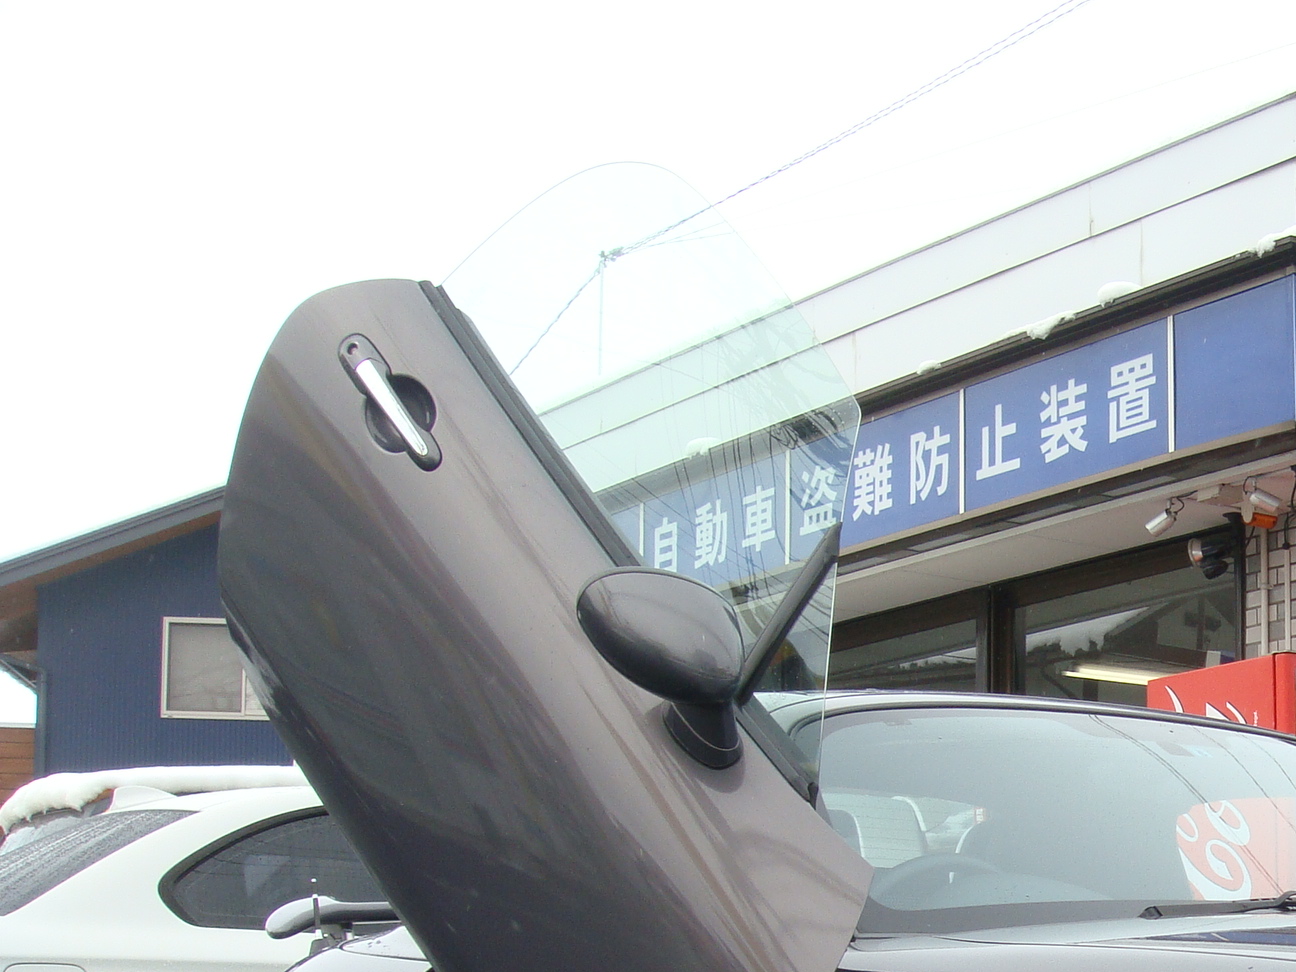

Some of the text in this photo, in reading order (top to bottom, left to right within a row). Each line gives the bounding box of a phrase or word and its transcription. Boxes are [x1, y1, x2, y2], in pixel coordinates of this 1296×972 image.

[653, 352, 1158, 572] 自動車盗難防止装置
